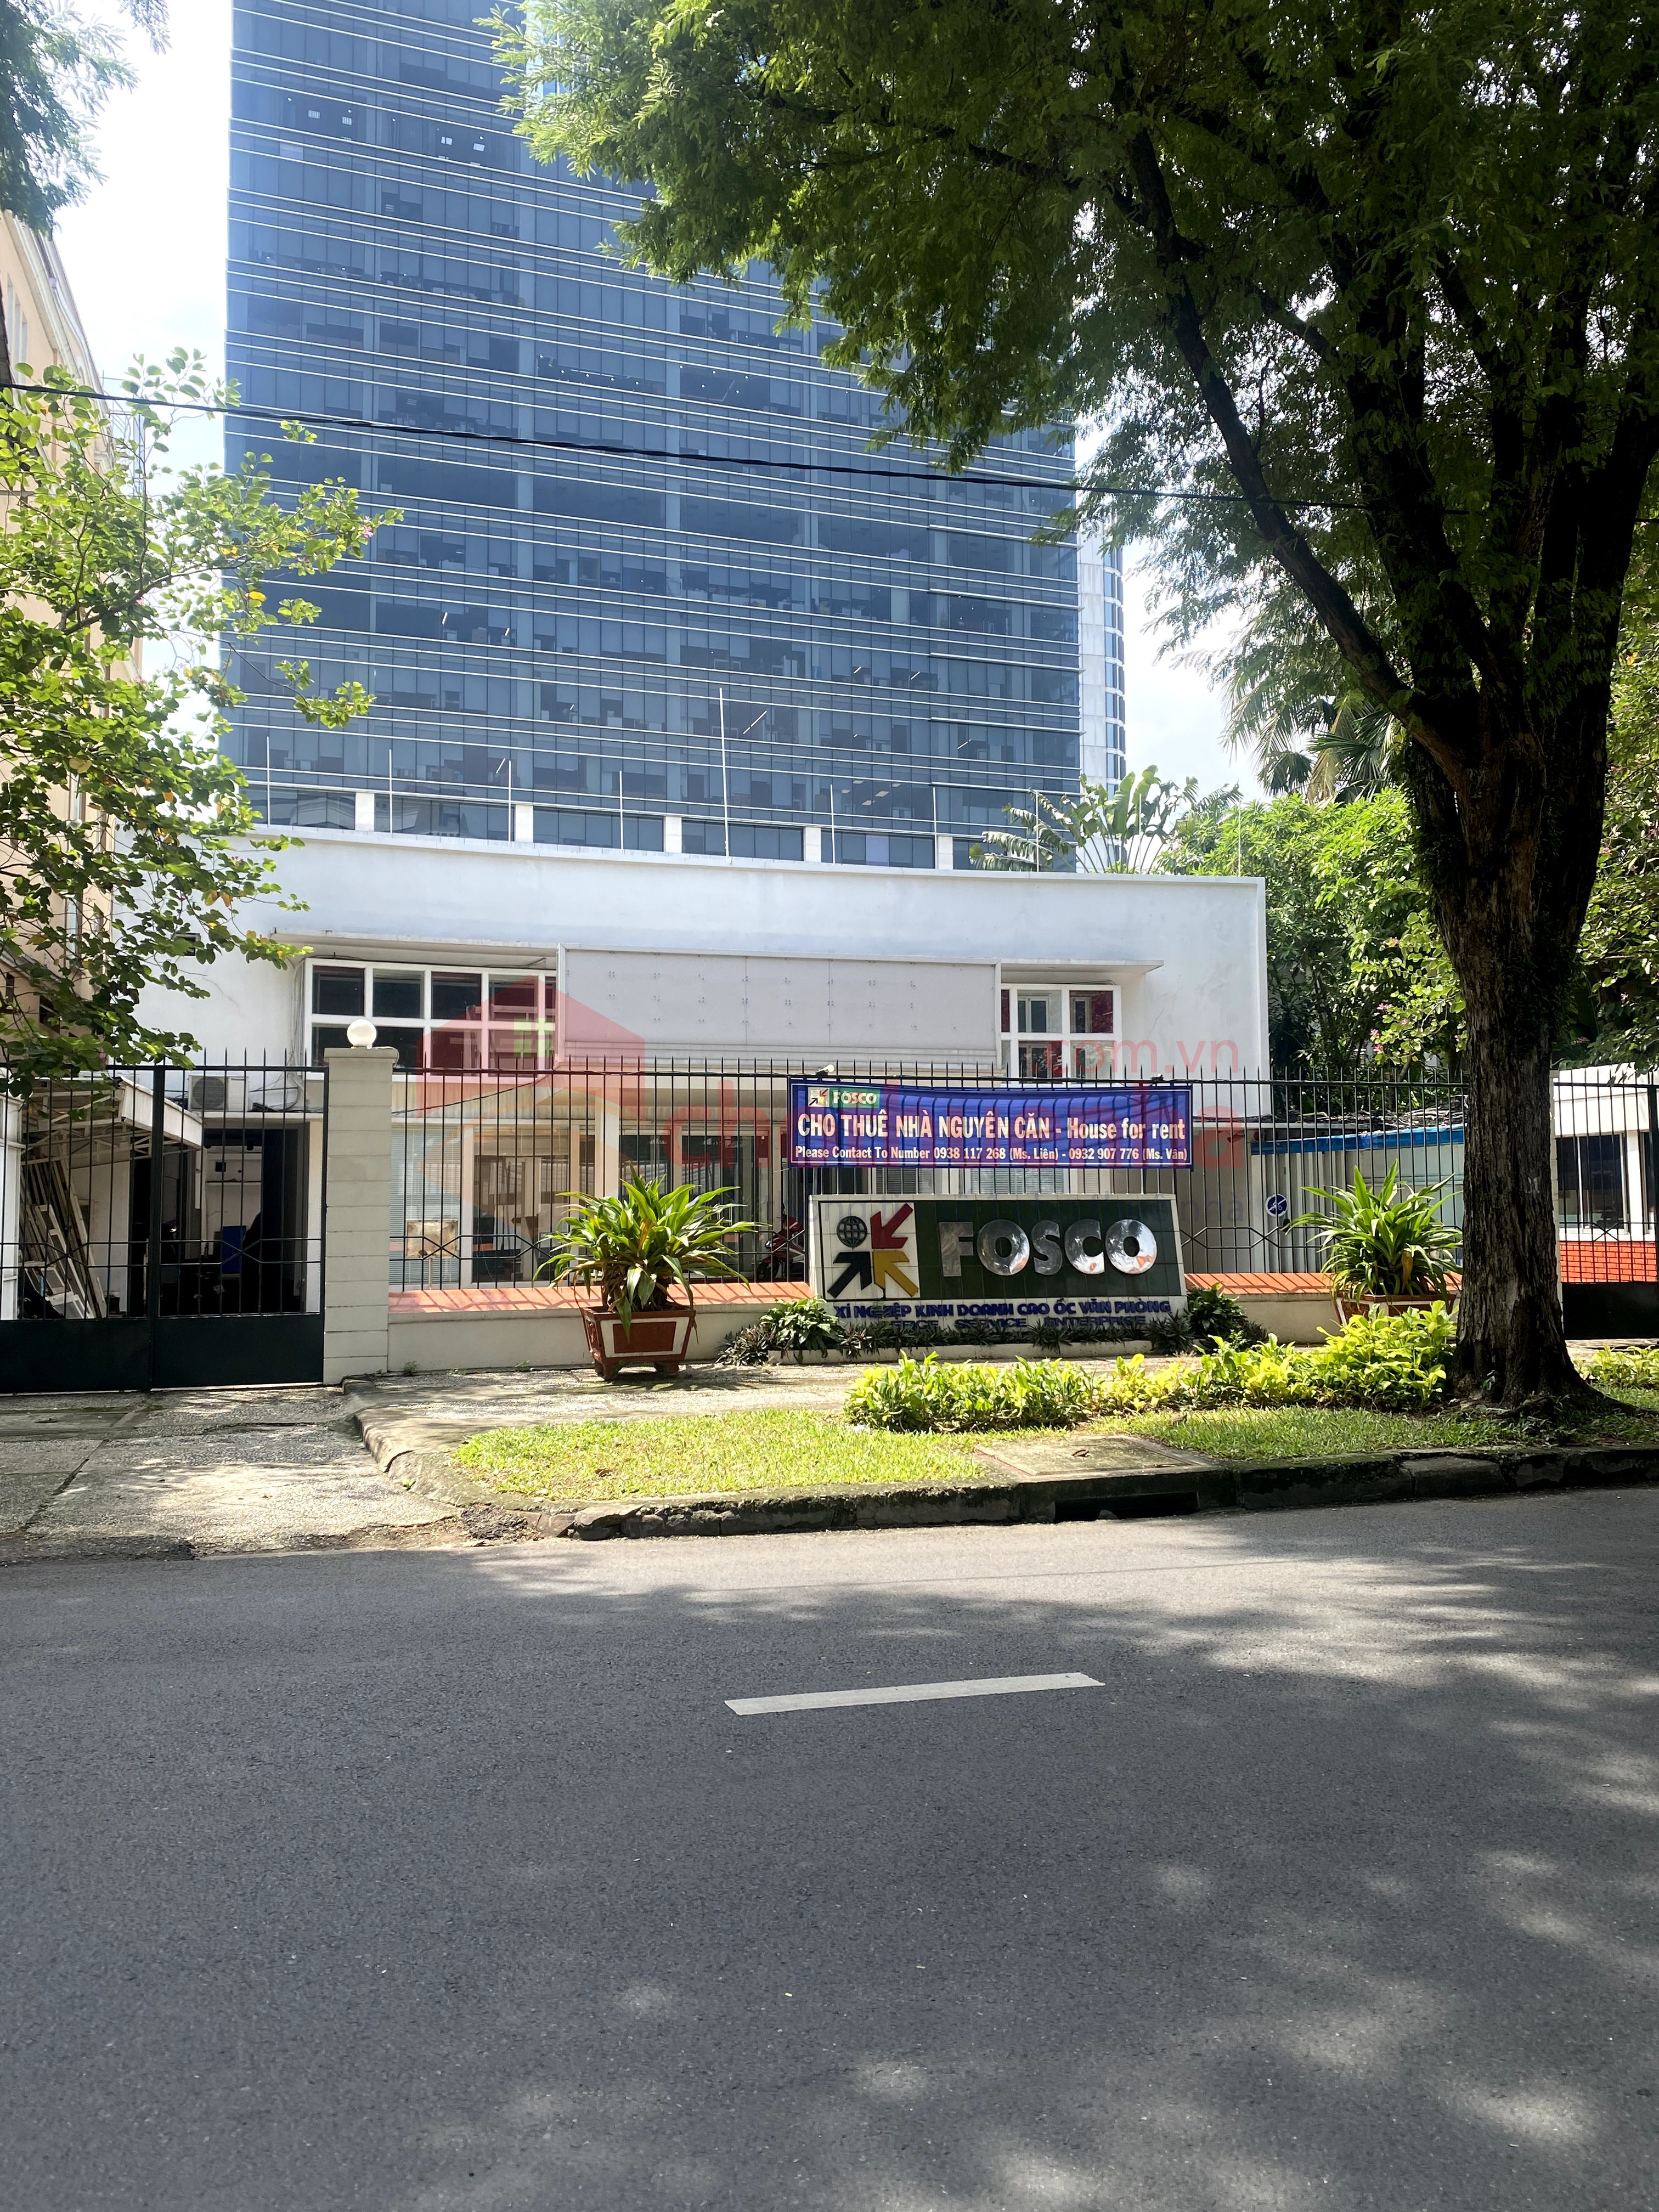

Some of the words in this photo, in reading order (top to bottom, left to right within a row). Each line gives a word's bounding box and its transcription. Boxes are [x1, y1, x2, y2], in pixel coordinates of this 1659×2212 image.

[833, 1090, 877, 1104] FOSCO
[798, 1113, 836, 1137] CHO
[840, 1109, 888, 1138] THUÊ
[896, 1109, 933, 1138] NHÀ
[939, 1110, 1009, 1139] NGUYÊN
[1014, 1112, 1050, 1139] CĂN
[1067, 1117, 1116, 1139] House
[1122, 1117, 1146, 1139] for
[1152, 1118, 1186, 1139] rent
[795, 1146, 829, 1158] Please
[832, 1146, 872, 1159] Contact
[874, 1147, 888, 1159] To
[891, 1147, 930, 1159] Number
[933, 1147, 960, 1160] 0938
[964, 1148, 982, 1160] 117
[986, 1148, 1006, 1160] 268
[1009, 1147, 1031, 1161] (Ms.
[1034, 1147, 1058, 1161] Liên)
[1069, 1148, 1095, 1160] 0932
[1097, 1148, 1116, 1160] 907
[1120, 1148, 1139, 1160] 776
[1143, 1148, 1163, 1161] (Ms.
[1166, 1148, 1188, 1161] Vân)
[939, 1218, 1158, 1277] FOSCO
[834, 1304, 851, 1318] XÍ
[916, 1304, 953, 1317] KINH
[957, 1304, 1014, 1316] DOANH
[1017, 1302, 1050, 1316] CAO
[1054, 1298, 1076, 1314] ỐC
[1079, 1298, 1111, 1314] VĂN
[1114, 1298, 1171, 1313] PHÒNG
